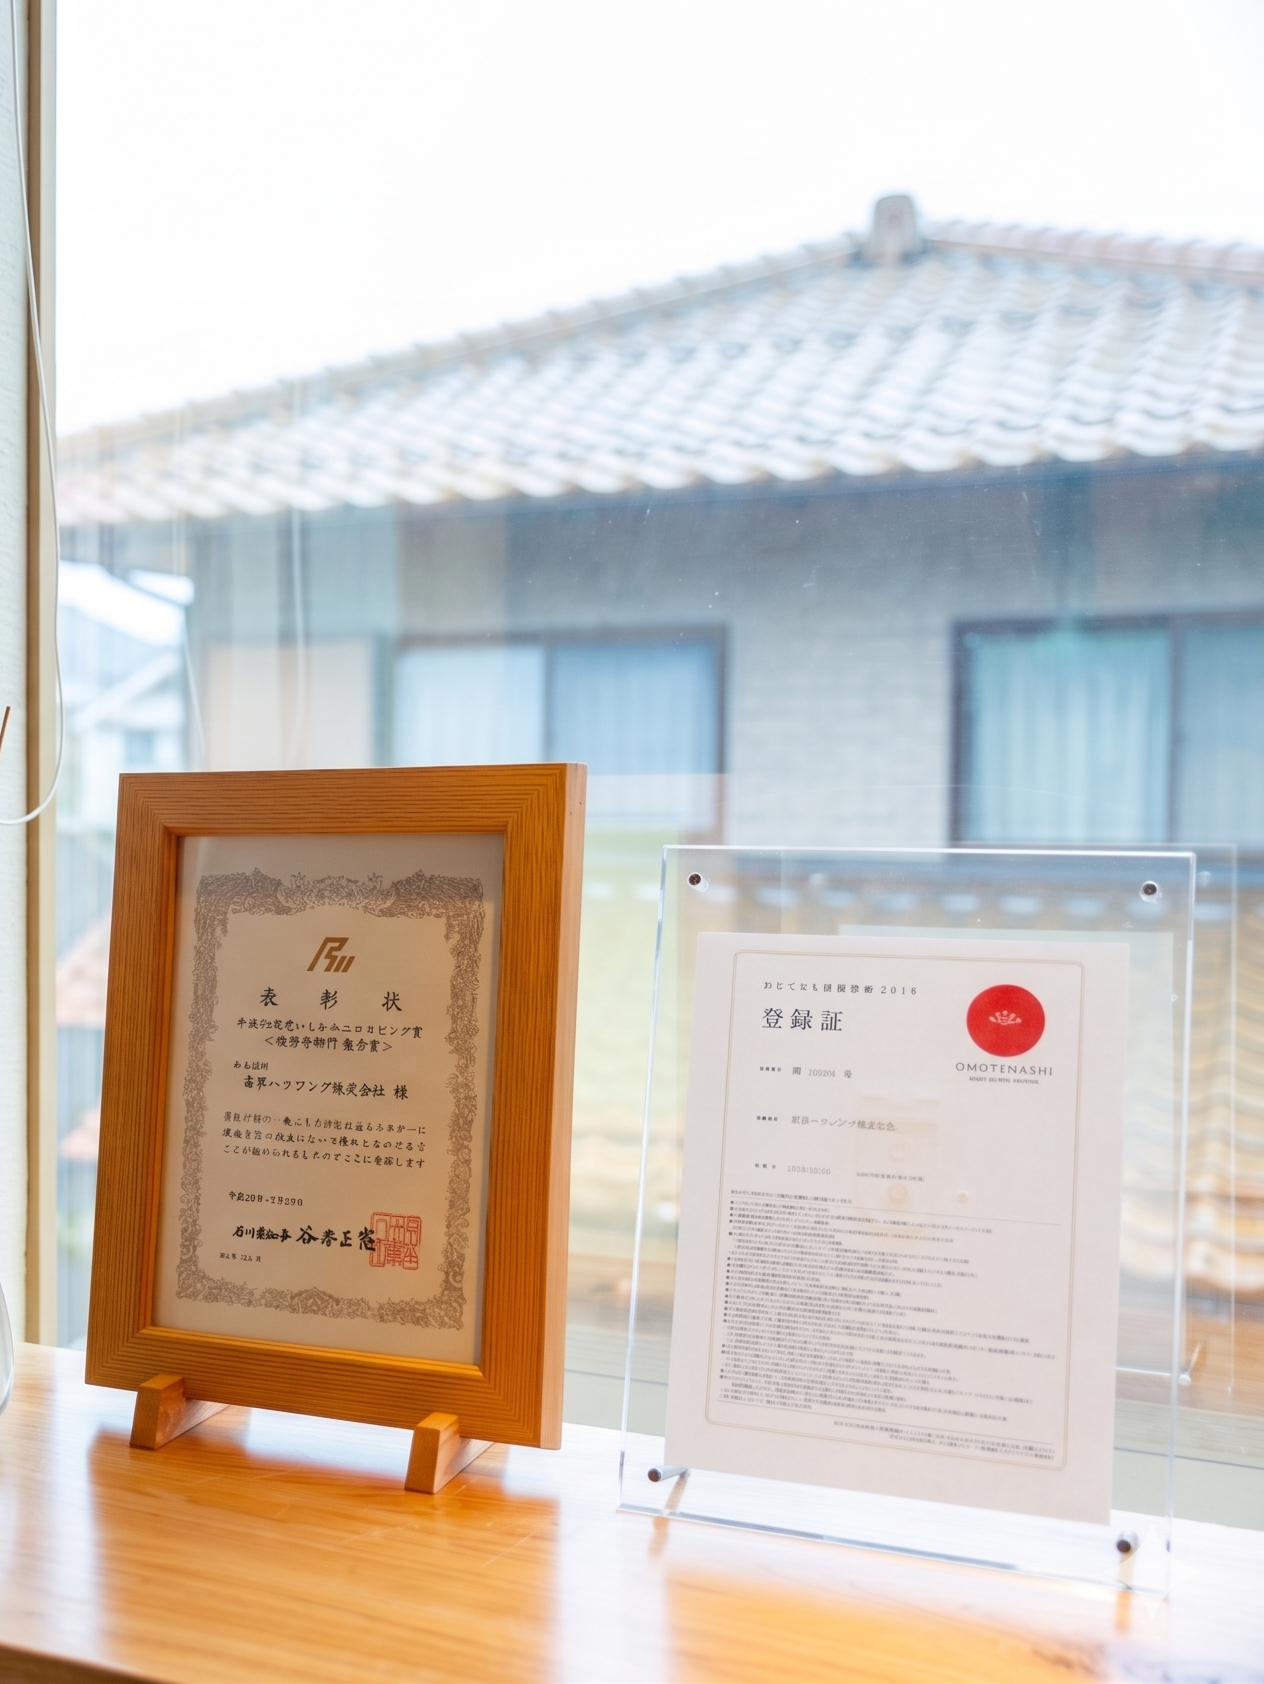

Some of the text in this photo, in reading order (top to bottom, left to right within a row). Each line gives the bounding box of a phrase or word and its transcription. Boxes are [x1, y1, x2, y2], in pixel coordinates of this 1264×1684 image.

[260, 986, 403, 1012] 表彰状
[761, 1007, 843, 1032] 登録証
[955, 1062, 1053, 1076] OMOTENASHI
